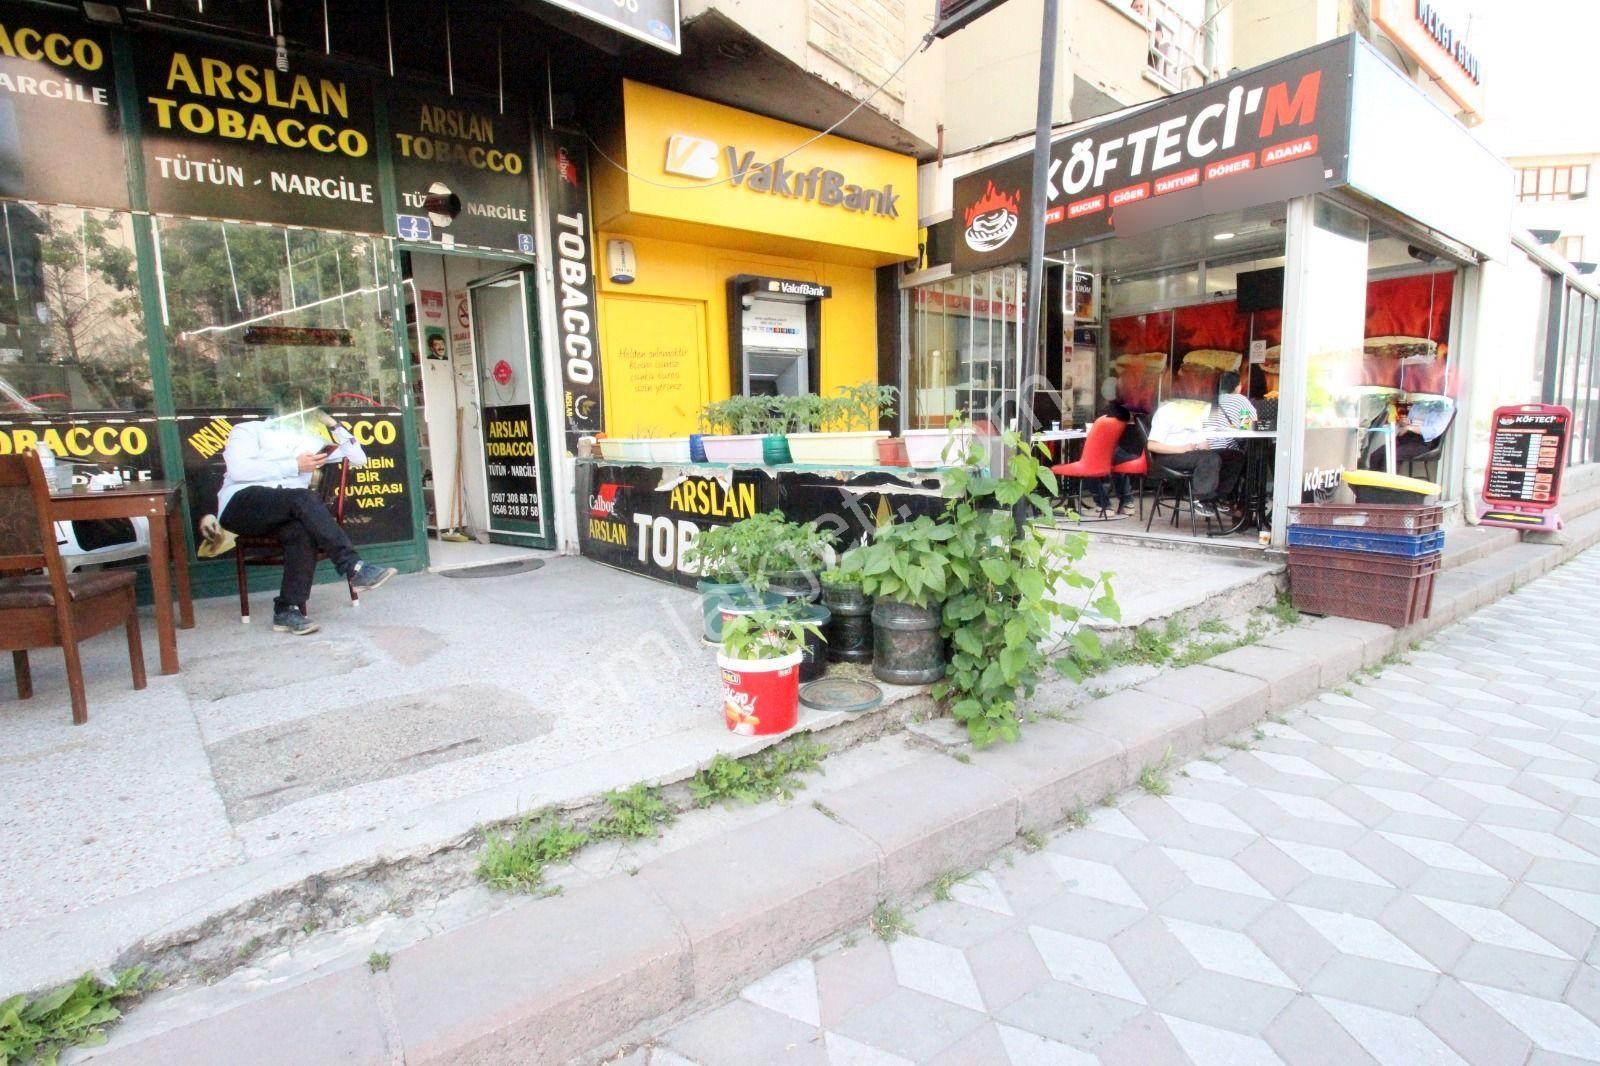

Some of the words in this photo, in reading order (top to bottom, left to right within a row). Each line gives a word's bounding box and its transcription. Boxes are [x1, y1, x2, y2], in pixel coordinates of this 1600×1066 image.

[166, 52, 348, 119] ARSLAN
[148, 97, 368, 158] TOBACCO
[420, 104, 493, 144] ARSLAN
[396, 133, 522, 175] TOBACCO
[155, 154, 244, 188] TÜTÜN
[270, 170, 374, 204] NARGİLE
[1070, 200, 1102, 215] SUCUK
[1207, 157, 1250, 178] DÖNER
[1265, 141, 1313, 162] ADANA
[467, 203, 528, 222] NARGİLE
[557, 212, 594, 385] TOBACCO
[188, 416, 233, 459] ARSLAN
[489, 420, 528, 438] ARSLAN
[487, 442, 535, 457] TOBACCO
[488, 462, 507, 476] TÜTÜN
[356, 471, 380, 483] BİR
[356, 498, 385, 509] VAR
[670, 479, 756, 519] ARSLAN
[588, 518, 628, 545] ARSLAN
